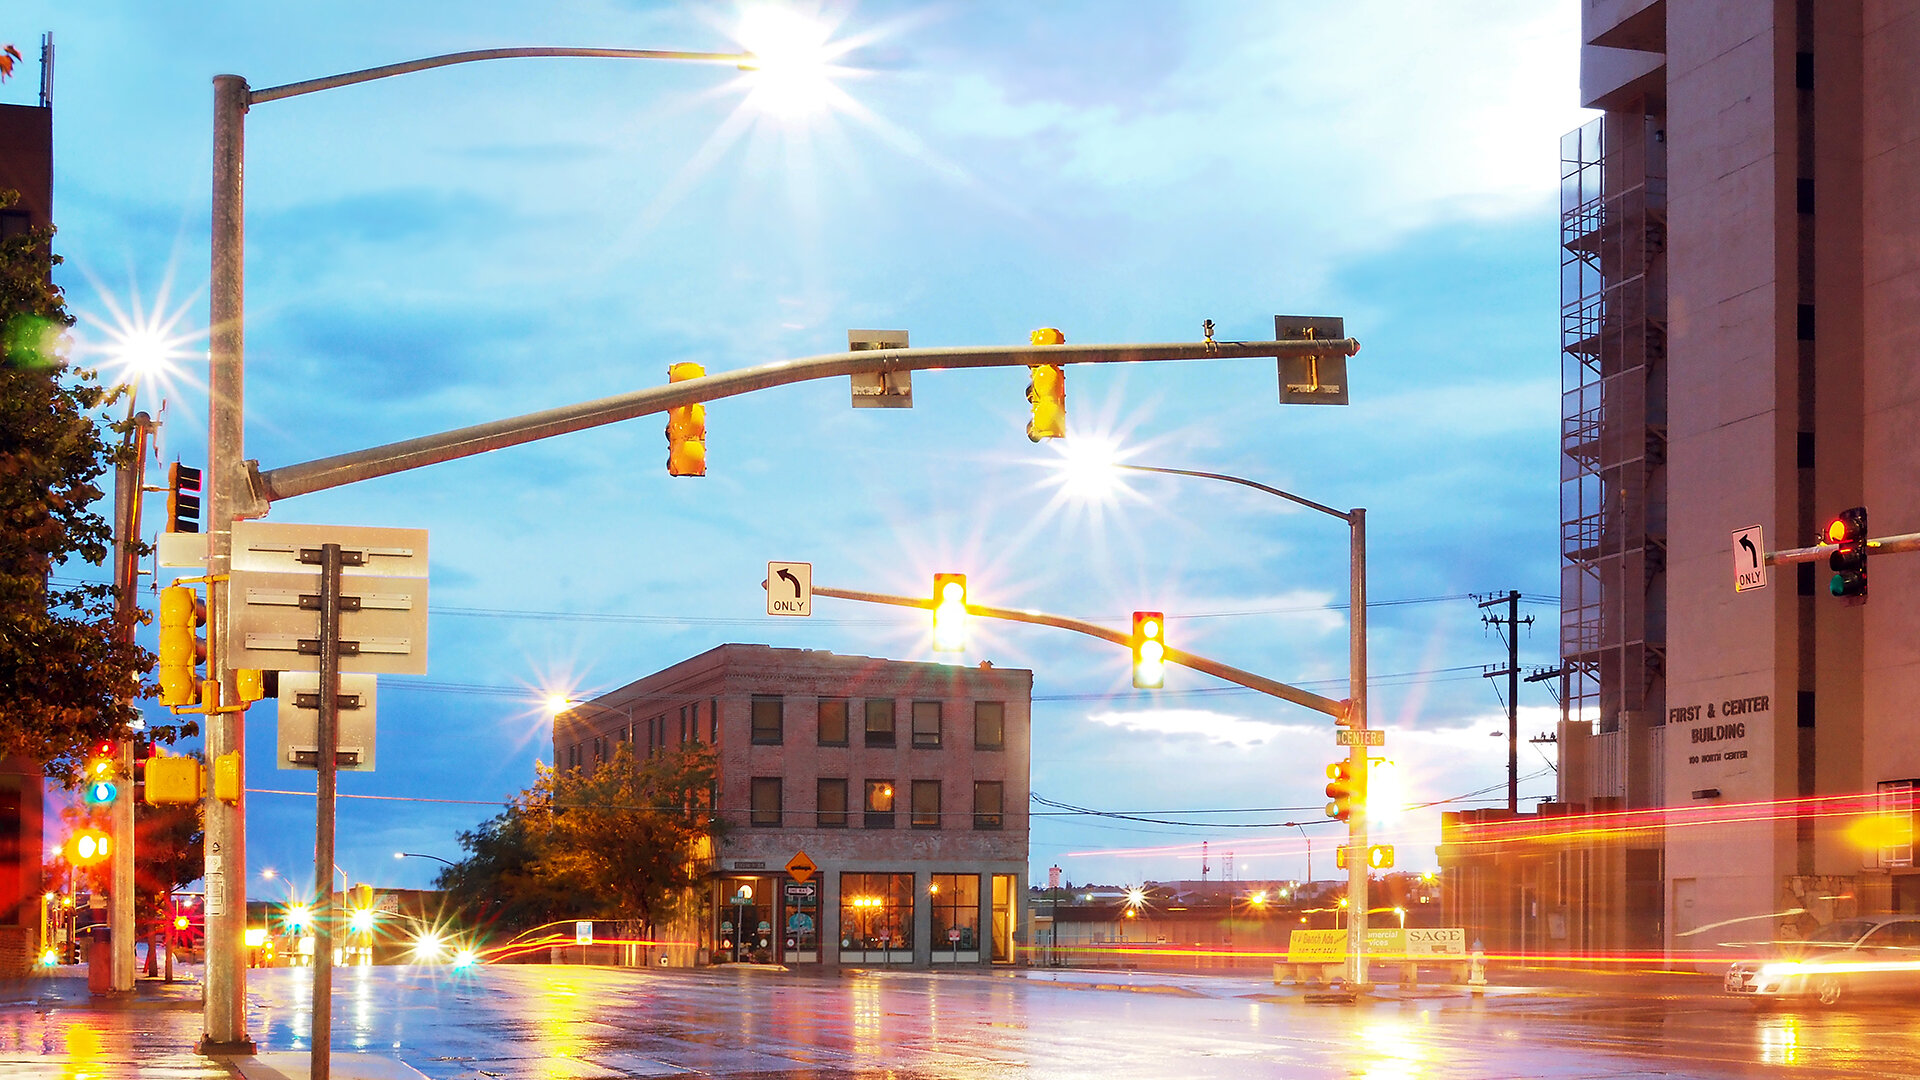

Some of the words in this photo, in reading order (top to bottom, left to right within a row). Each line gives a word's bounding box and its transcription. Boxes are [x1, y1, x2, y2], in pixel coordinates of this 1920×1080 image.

[1739, 571, 1761, 586] ONLY
[774, 602, 804, 611] ONLY
[1669, 705, 1701, 723] FIRST
[1707, 703, 1716, 719] &
[1722, 695, 1769, 717] CENTER
[1341, 731, 1377, 745] CENTER
[1377, 734, 1384, 743] ST
[1691, 722, 1745, 744] BUILDING
[1689, 755, 1699, 765] 100
[1701, 753, 1722, 763] NORTH
[1724, 750, 1748, 761] CENTER
[1409, 930, 1461, 942] SAGE
